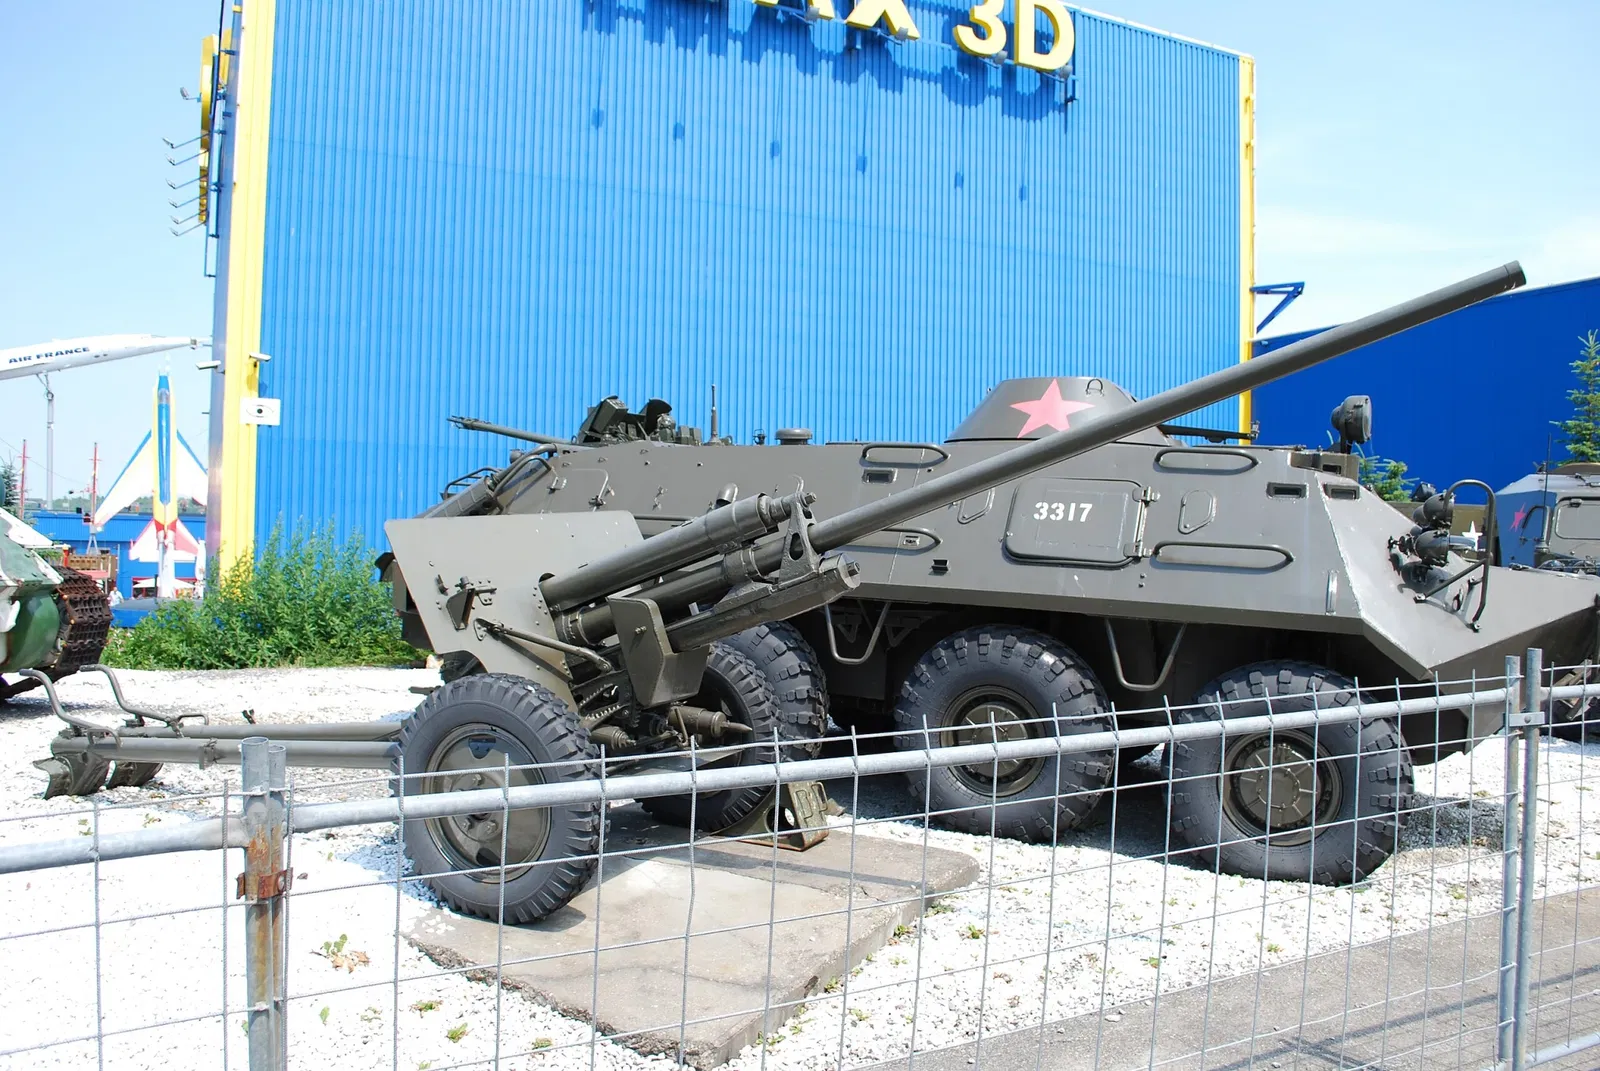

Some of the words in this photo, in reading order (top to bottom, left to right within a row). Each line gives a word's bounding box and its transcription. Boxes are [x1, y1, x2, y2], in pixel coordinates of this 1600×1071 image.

[952, 0, 1075, 72] 3D
[8, 355, 33, 364] AIR
[36, 347, 90, 360] FRANCE
[1033, 501, 1093, 523] 3317
